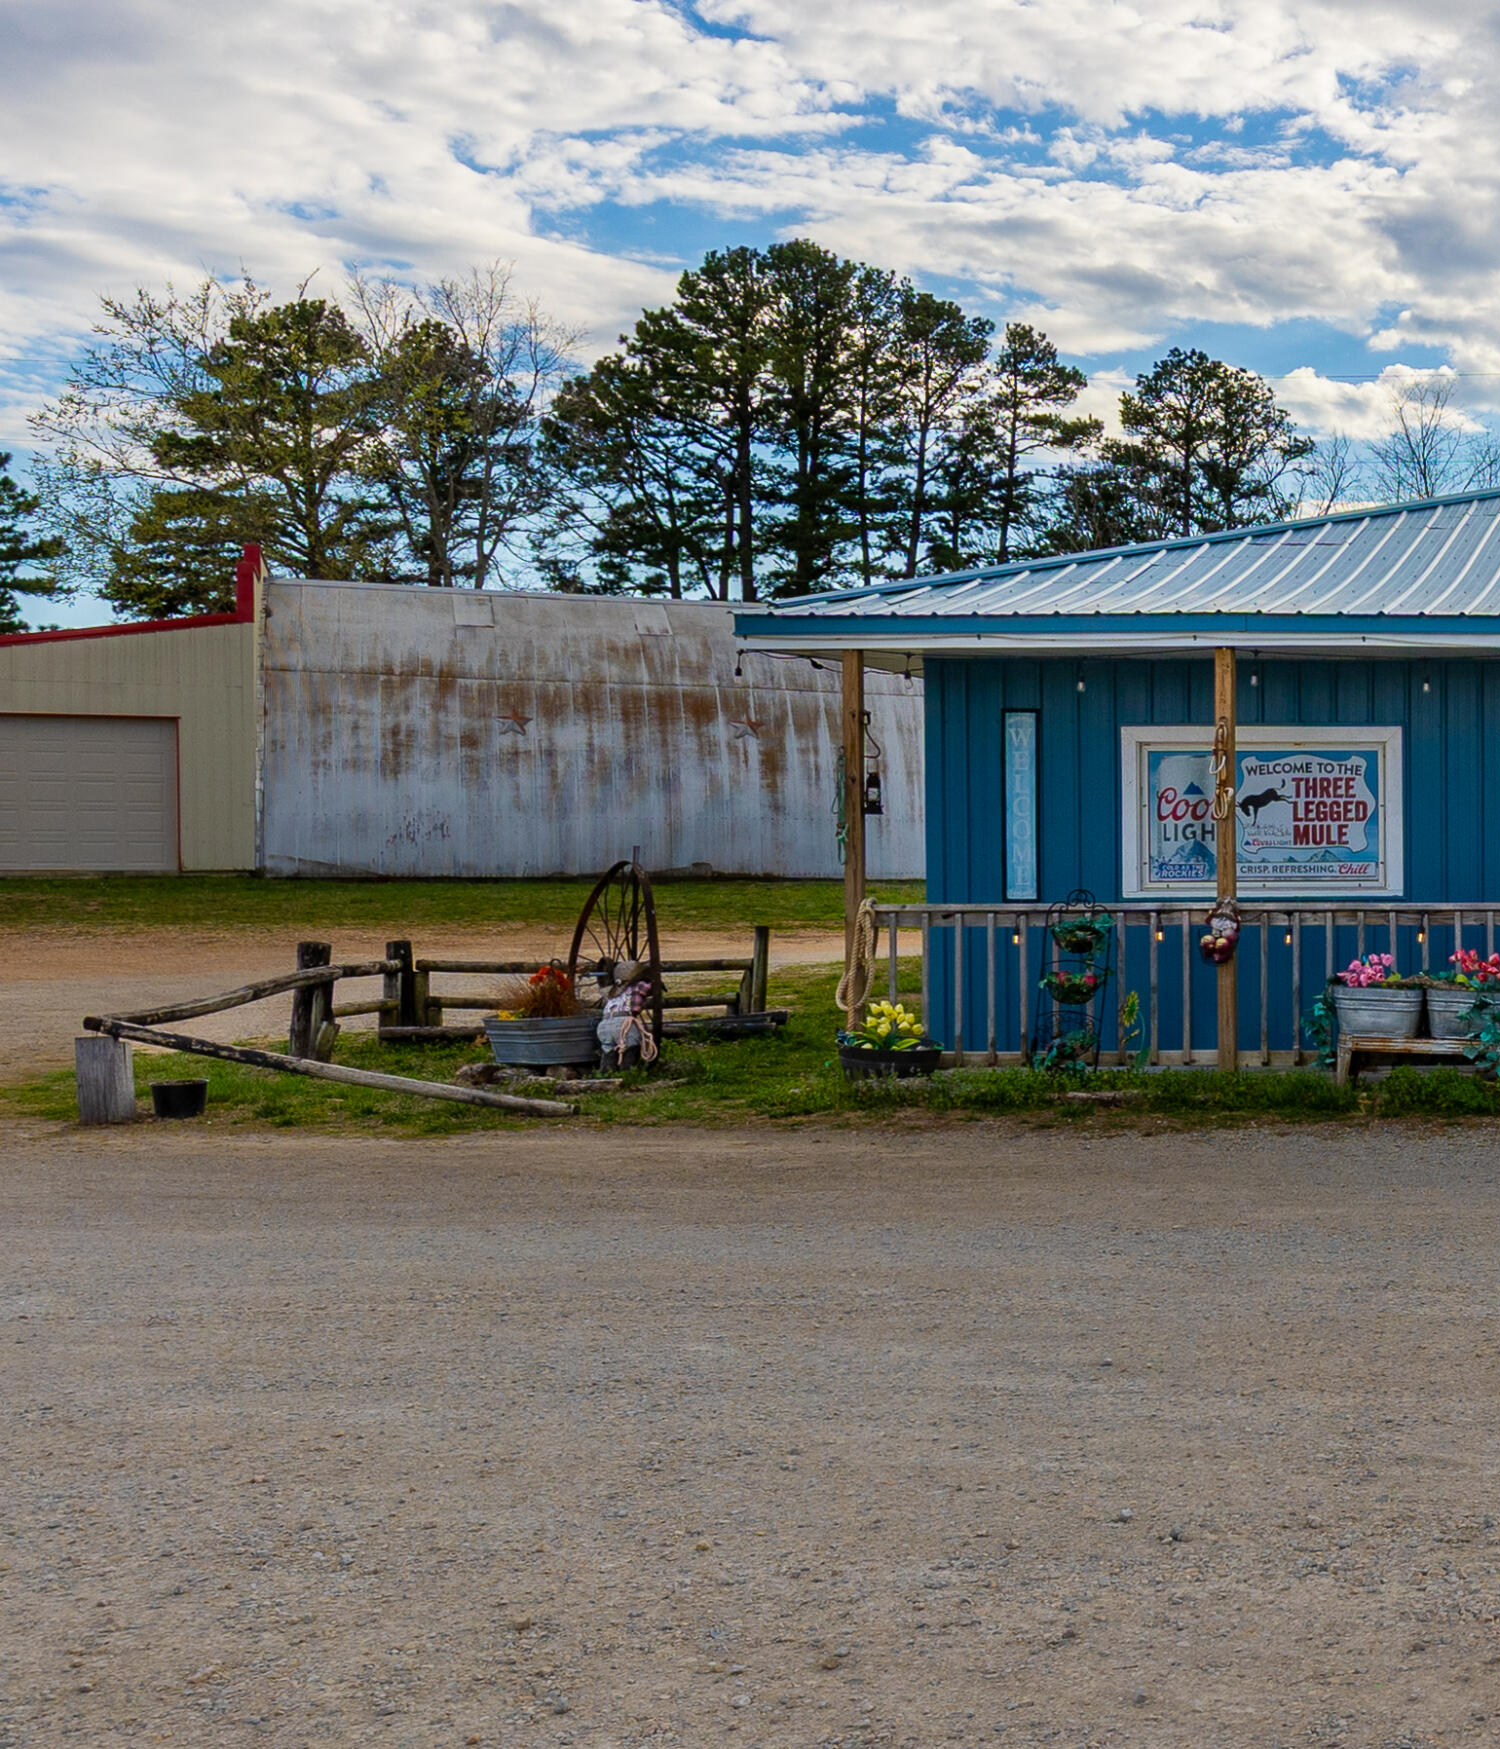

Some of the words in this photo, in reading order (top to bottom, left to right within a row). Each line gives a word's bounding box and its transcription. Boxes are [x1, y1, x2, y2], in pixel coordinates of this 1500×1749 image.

[1245, 762, 1313, 777] WELCOME
[1317, 762, 1335, 774] TO
[1337, 763, 1362, 776] THE
[1291, 777, 1356, 799] THREE
[1008, 727, 1033, 886] WELCOME
[1157, 787, 1218, 821] Coo
[1293, 800, 1368, 822] LEGGED
[1163, 823, 1217, 842] LIGH
[1293, 824, 1349, 846] MULE
[1240, 865, 1270, 874] CRISP.
[1272, 864, 1336, 874] REFRESHING.
[1338, 863, 1370, 875] Chill
